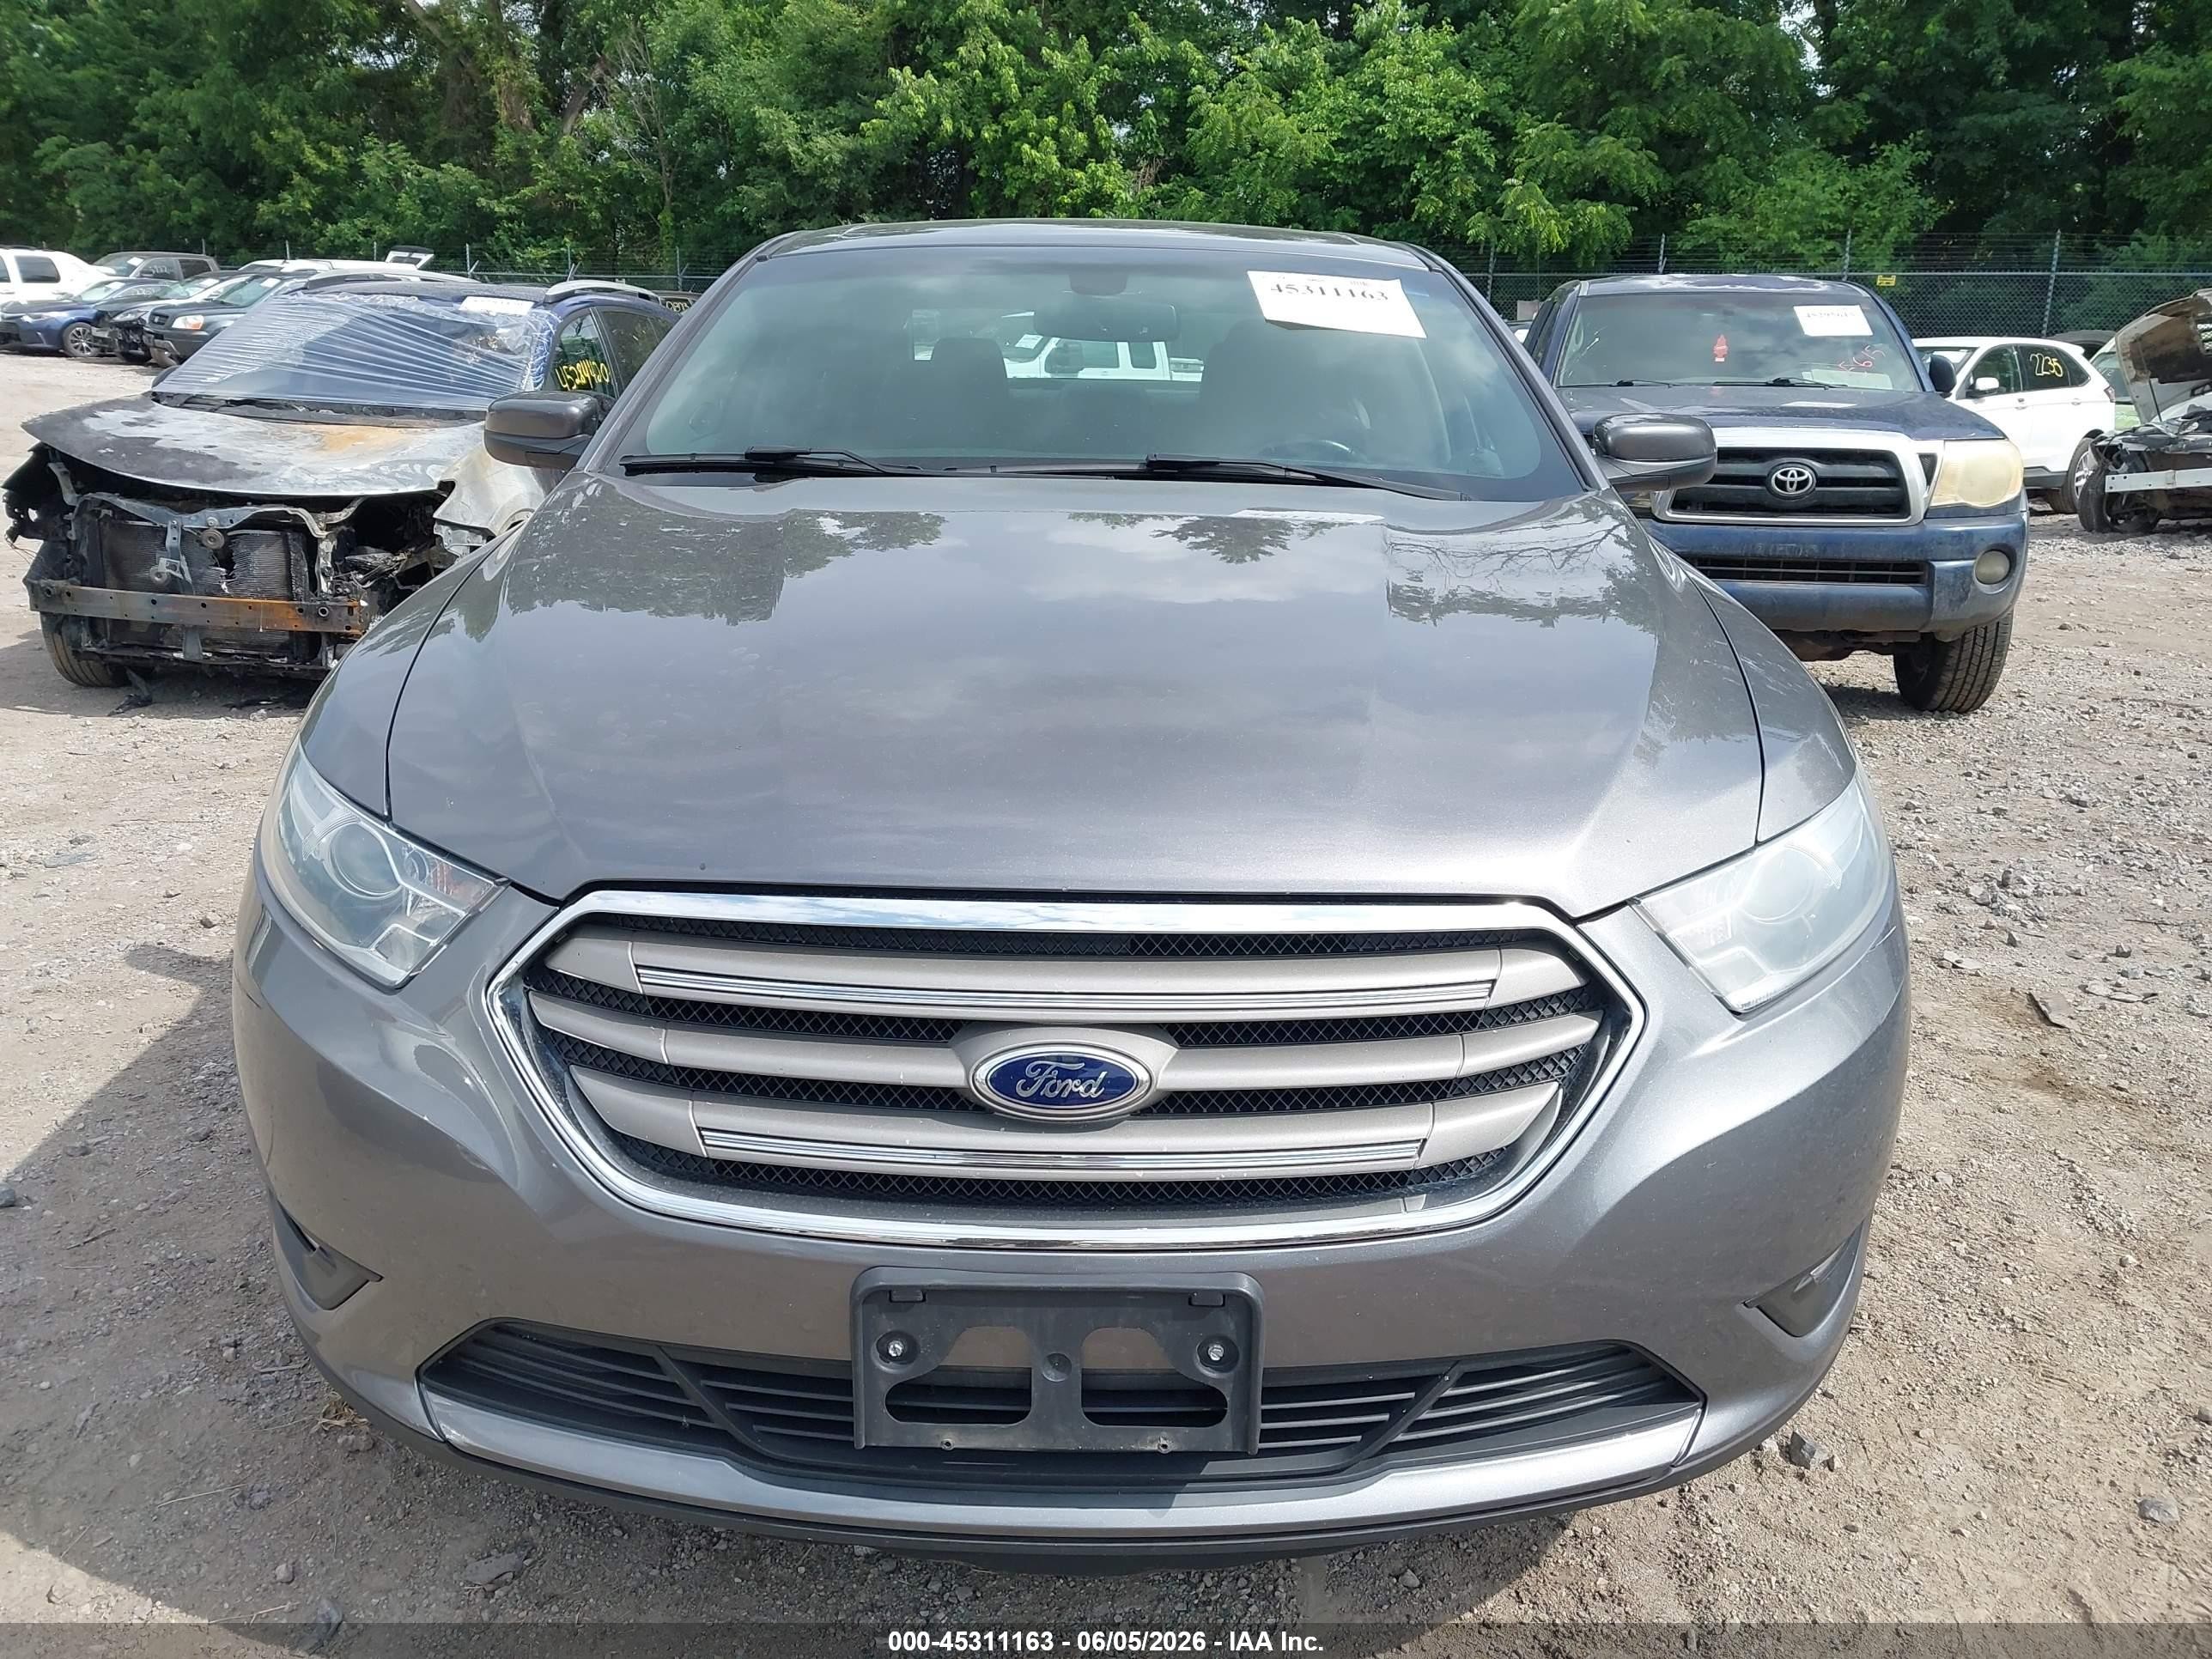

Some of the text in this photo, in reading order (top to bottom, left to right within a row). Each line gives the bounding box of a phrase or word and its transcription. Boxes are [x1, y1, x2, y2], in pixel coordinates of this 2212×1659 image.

[1270, 283, 1389, 301] 45311163
[2029, 353, 2063, 378] 2235
[1016, 1060, 1108, 1098] Ford
